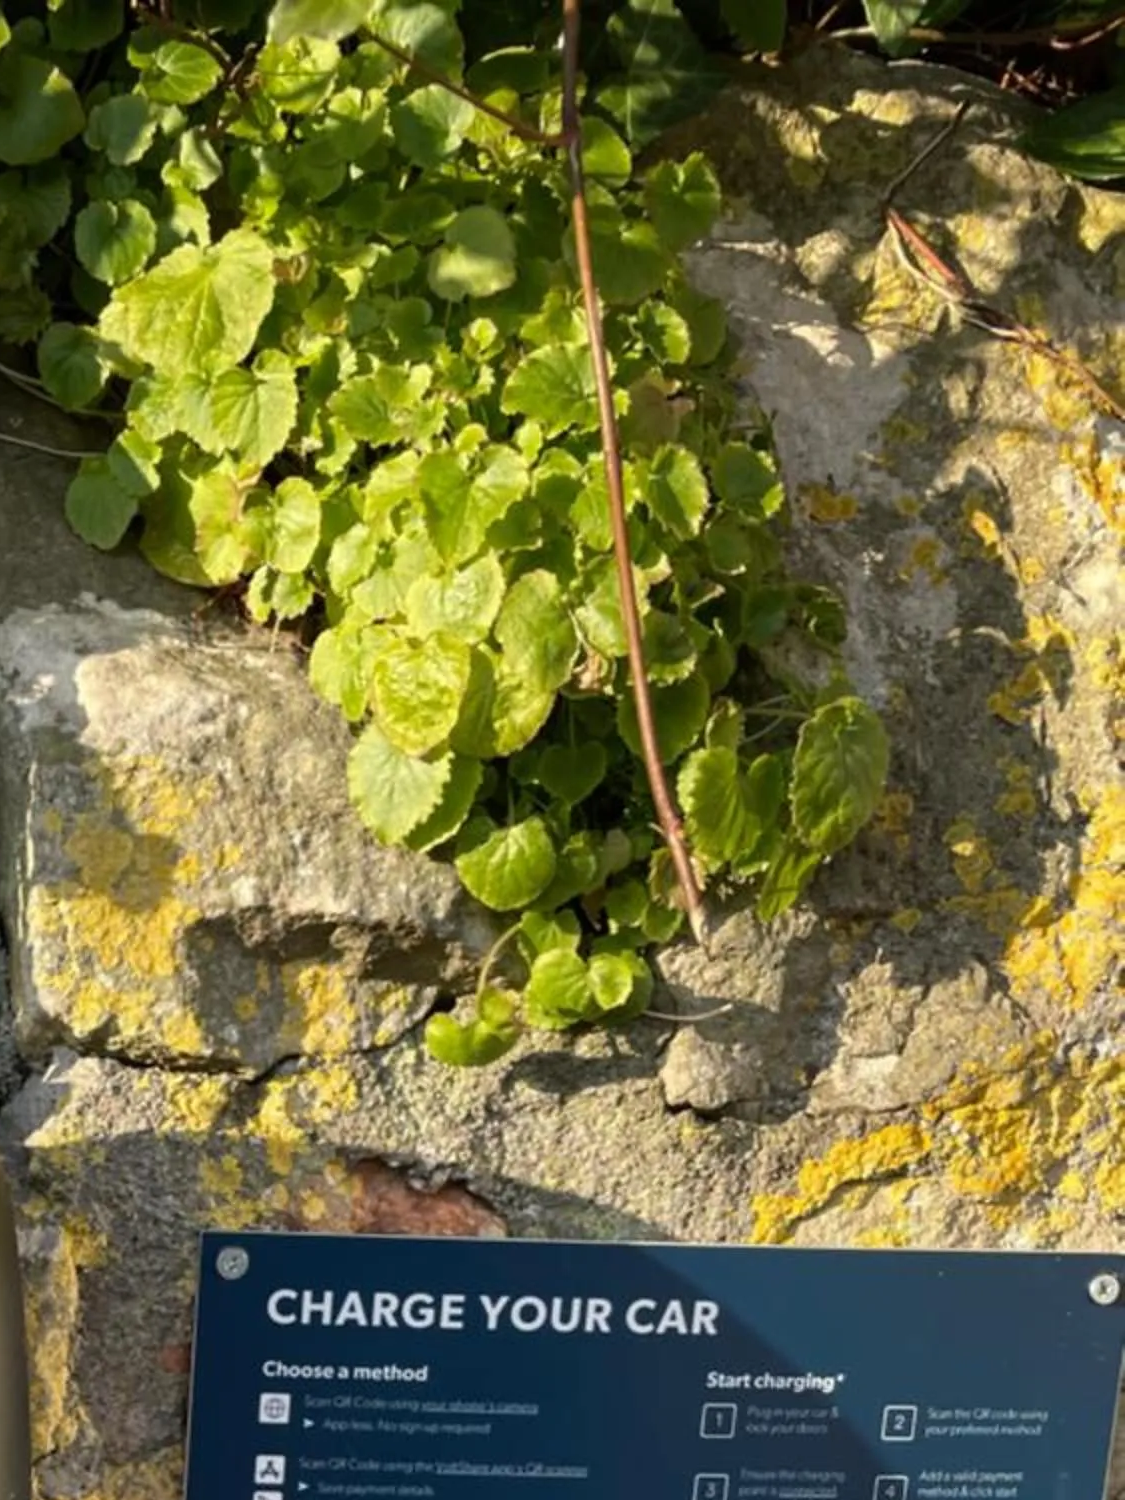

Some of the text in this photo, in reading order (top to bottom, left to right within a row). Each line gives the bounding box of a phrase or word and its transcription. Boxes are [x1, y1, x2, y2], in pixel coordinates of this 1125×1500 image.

[266, 1288, 720, 1336] CHARGE YOUR CAR
[262, 1360, 428, 1381] Choose a method
[706, 1371, 751, 1389] Start
[893, 1414, 906, 1430] 2
[704, 1482, 716, 1498] 3
[884, 1484, 896, 1498] 4
